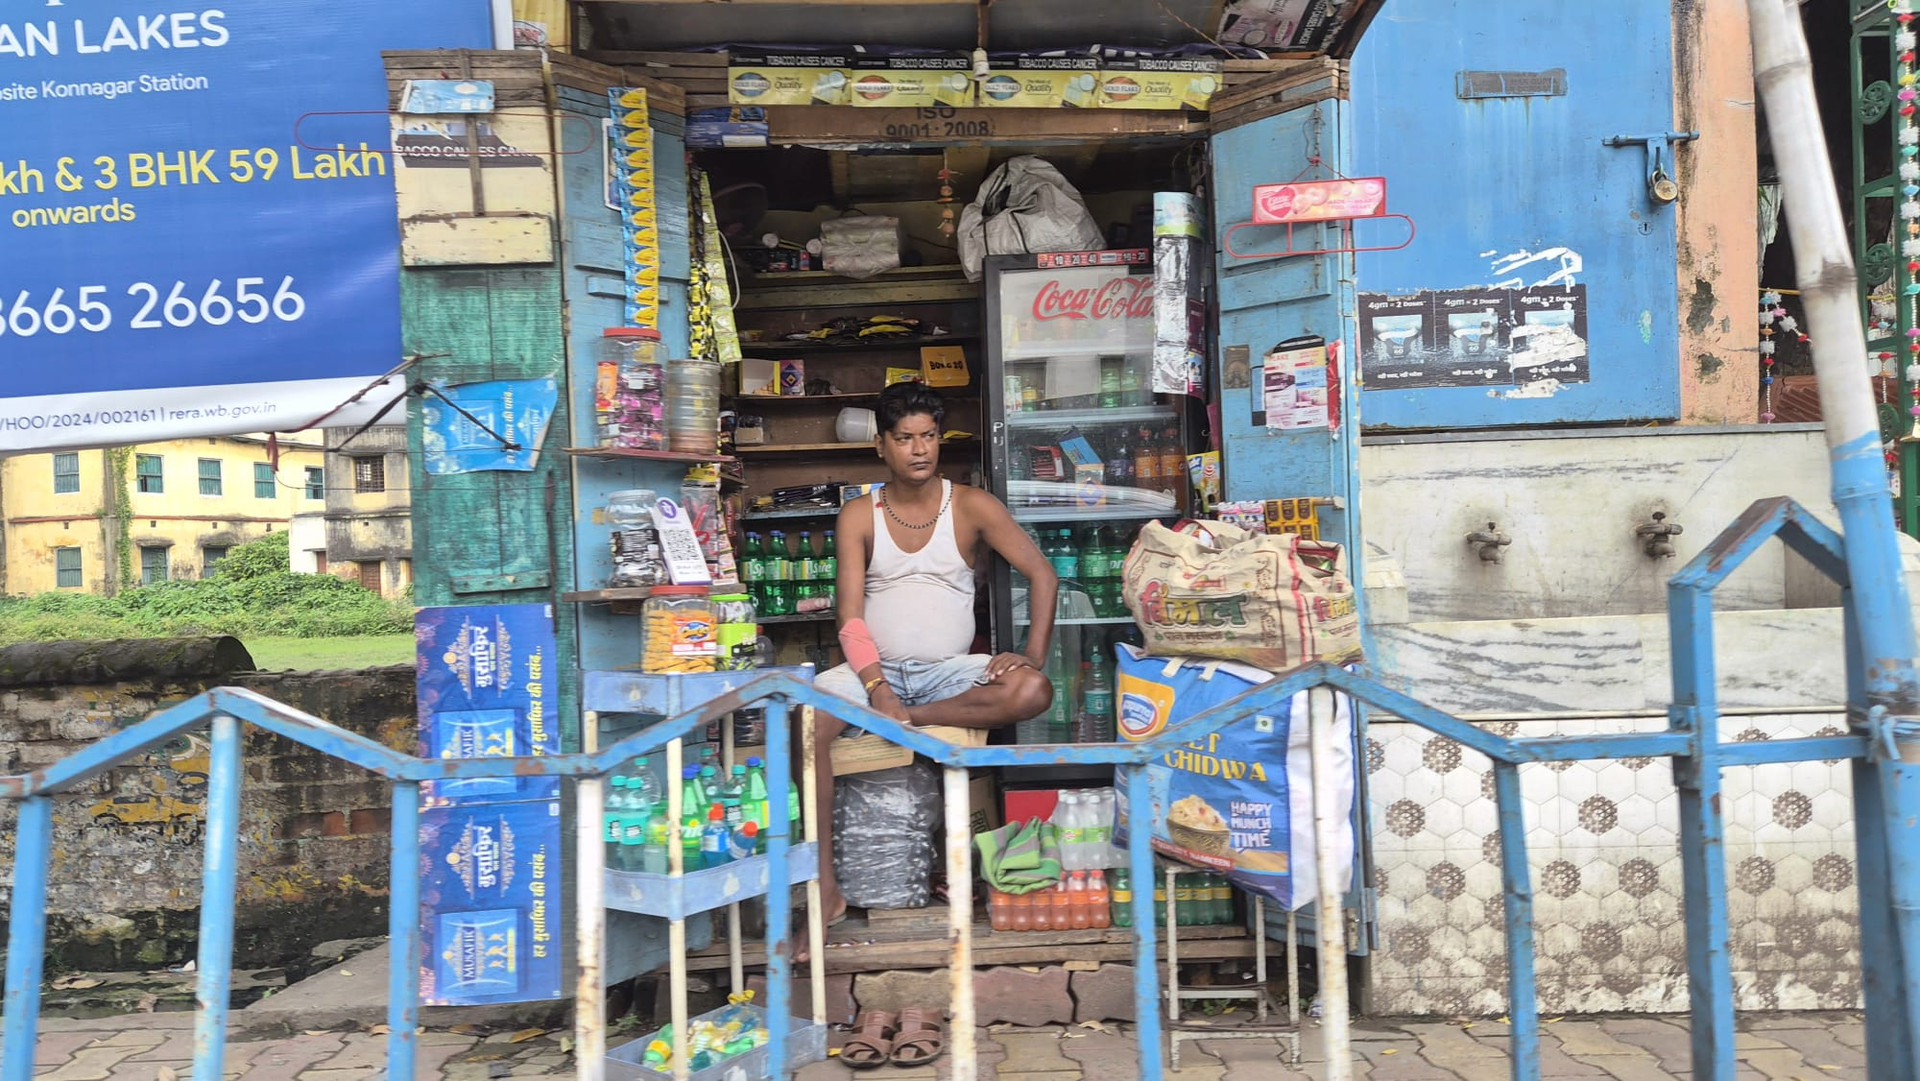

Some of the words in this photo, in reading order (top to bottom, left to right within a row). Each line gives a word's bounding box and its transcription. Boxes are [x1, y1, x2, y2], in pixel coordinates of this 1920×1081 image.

[75, 10, 230, 53] LAKES
[767, 56, 795, 67] TOBACCO
[796, 56, 819, 66] CAUSES
[820, 57, 846, 67] CANCER
[889, 58, 918, 69] TOBACCO
[919, 58, 942, 69] CAUSES
[943, 59, 968, 69] CANCER
[1018, 58, 1047, 69] TOBACCO
[1047, 59, 1072, 69] CAUSES
[1072, 58, 1098, 70] CANCER
[1139, 59, 1168, 71] TOBACCO
[1168, 60, 1192, 71] CAUSES
[41, 79, 136, 100] Konnagar
[139, 73, 209, 93] Station
[1025, 82, 1053, 94] Quality
[1145, 83, 1173, 94] Quality
[55, 156, 84, 191] &
[93, 155, 118, 190] 3
[128, 149, 221, 187] BHK
[229, 147, 279, 183] 59
[289, 141, 386, 179] Lakh
[12, 197, 137, 228] onwards
[127, 275, 306, 329] 26656
[1368, 301, 1388, 311] 4gm
[1397, 301, 1403, 309] 2
[1443, 298, 1465, 308] 4gm
[1520, 296, 1540, 304] 4gm
[169, 401, 277, 421] rera.wb.gov.in
[1163, 749, 1268, 782] CHIDWA
[1230, 801, 1272, 817] HAPPY
[1230, 816, 1271, 830] MUNCH
[1230, 830, 1271, 849] TIME
